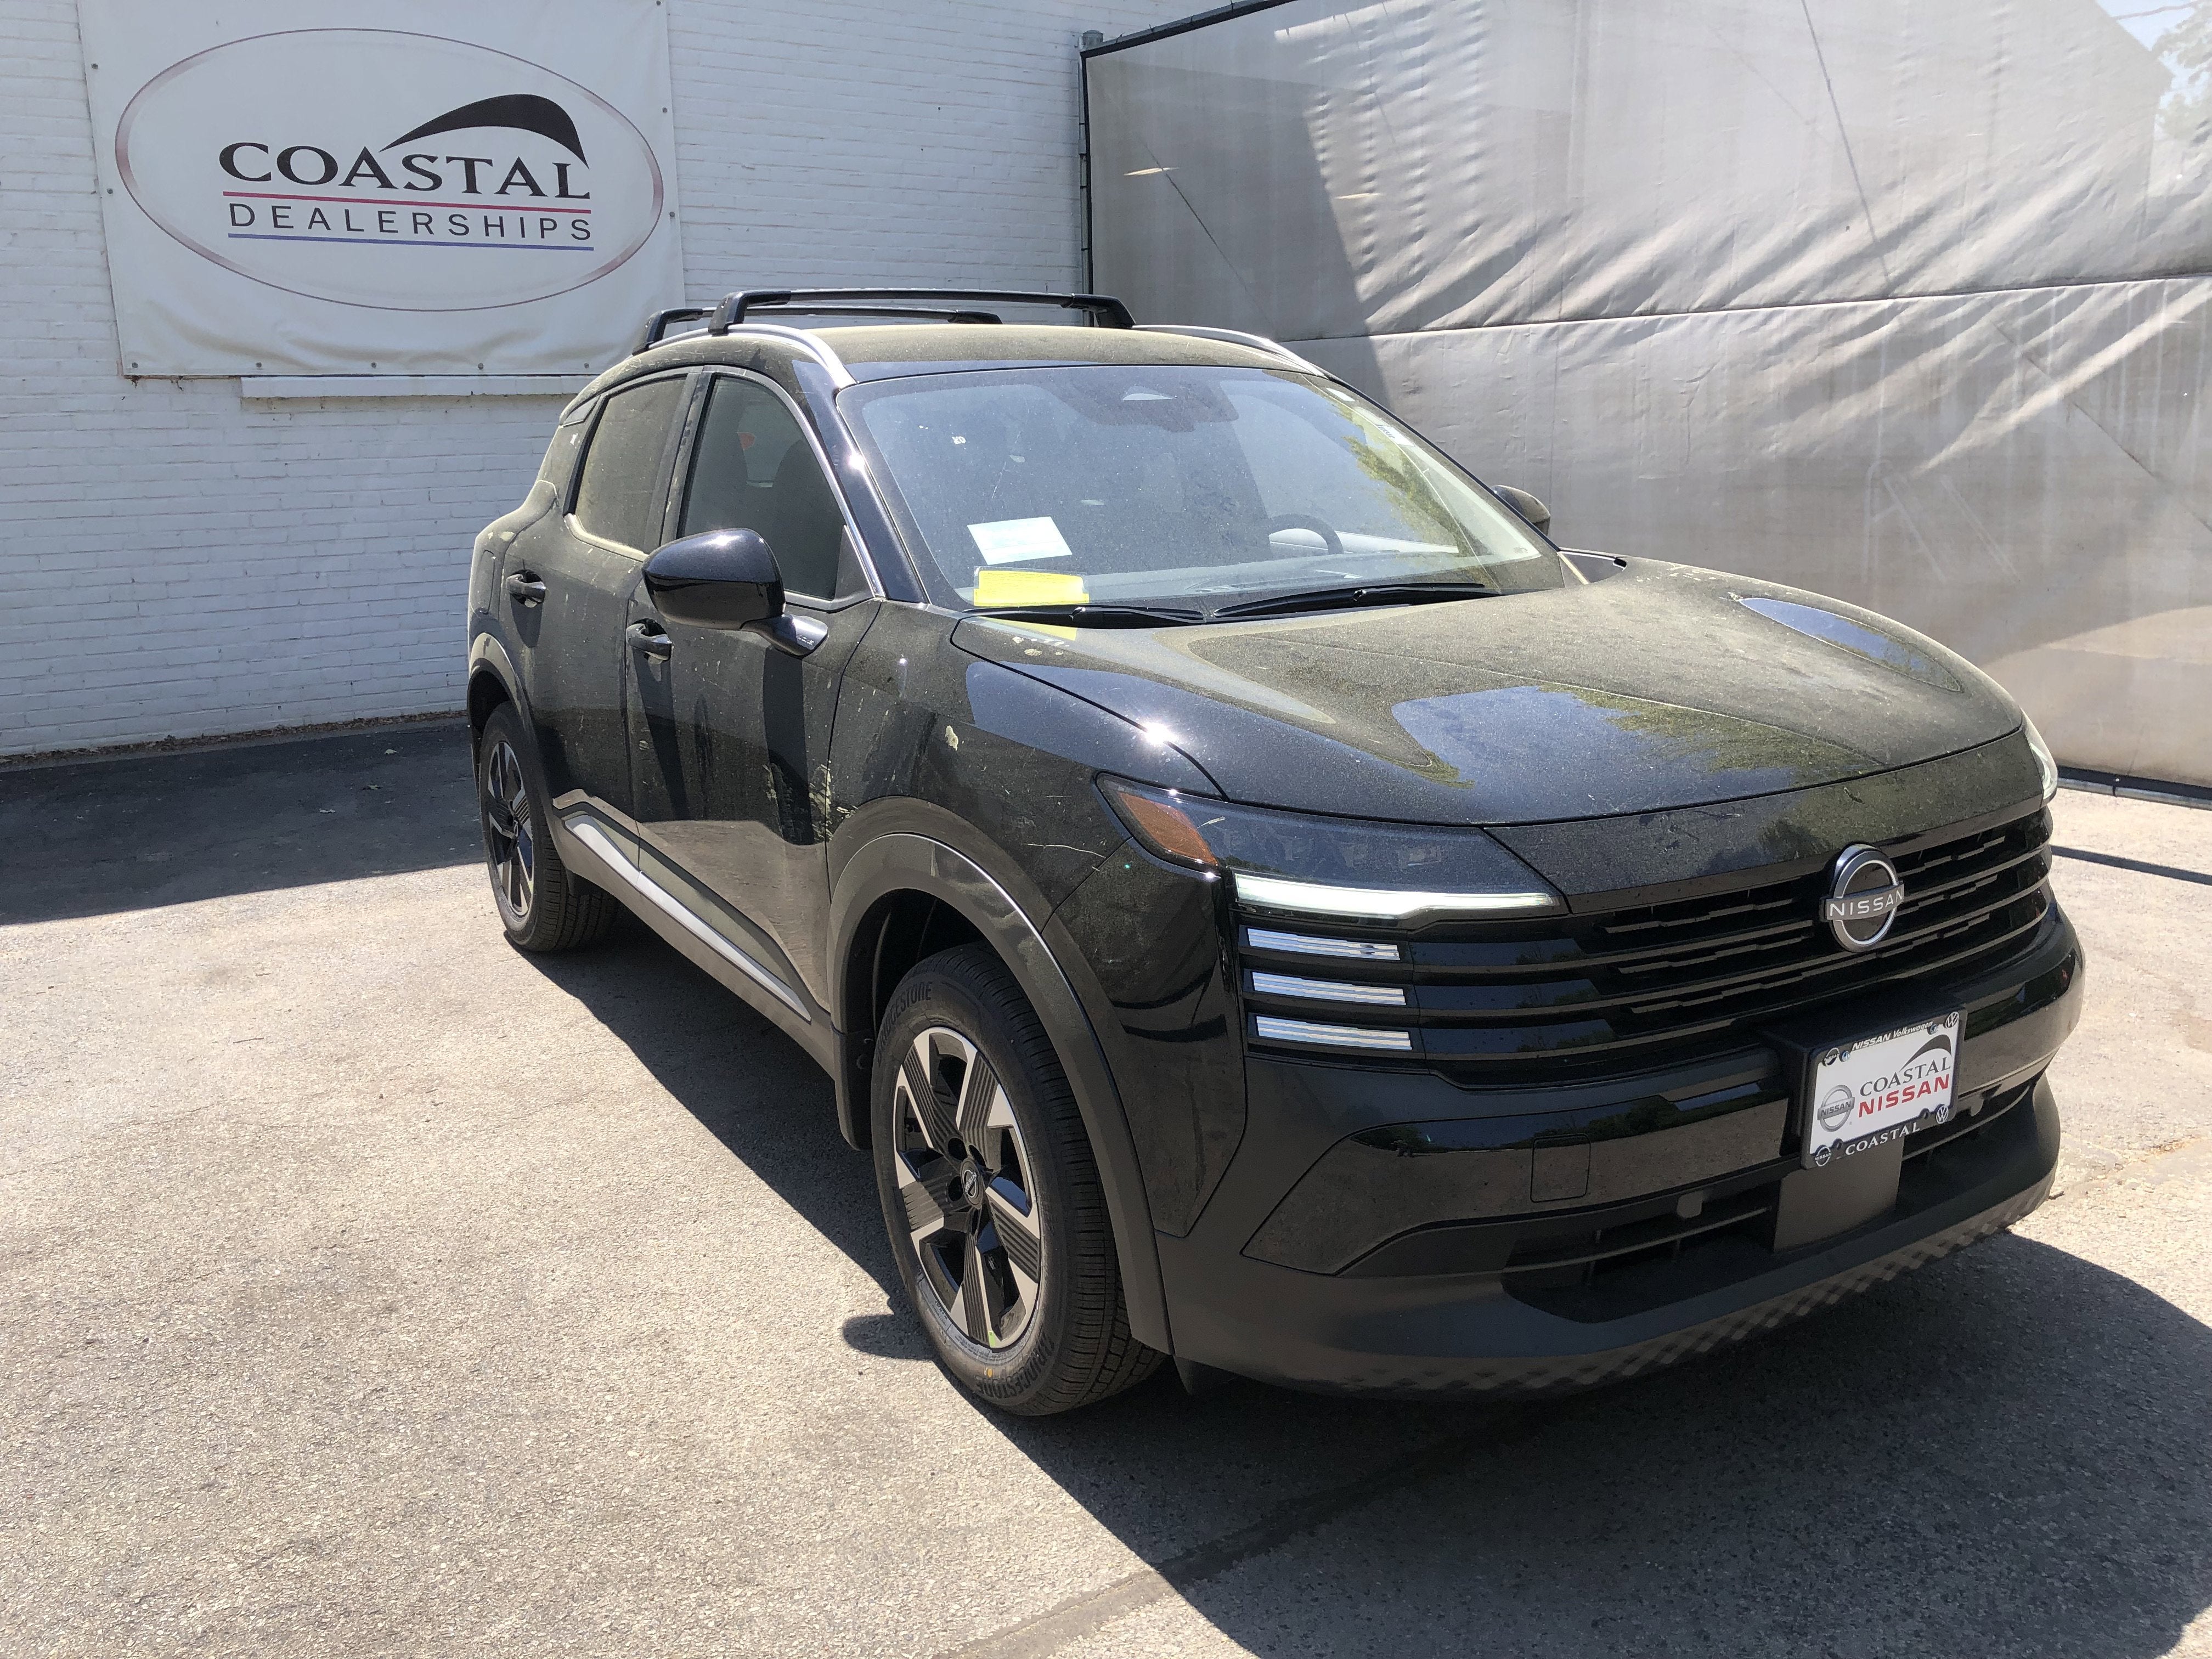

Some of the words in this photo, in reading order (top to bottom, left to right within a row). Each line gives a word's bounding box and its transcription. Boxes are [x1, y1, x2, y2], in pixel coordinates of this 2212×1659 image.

[219, 142, 591, 200] COASTAL
[229, 202, 592, 240] DEALERSHIPS
[1830, 890, 1903, 917] NISSAN
[877, 981, 933, 1068] BRIDGESTONE
[1852, 1033, 1891, 1051] NISSAN
[1893, 1021, 1933, 1038] Volkswagen
[1859, 1074, 1950, 1118] NISSAN
[1860, 1057, 1951, 1097] COASTAL
[1821, 1101, 1852, 1116] NISSAN
[1815, 1152, 1832, 1161] NISSAN
[1846, 1122, 1920, 1155] COASTAL
[974, 1330, 1055, 1399] BRIDGESTONE
